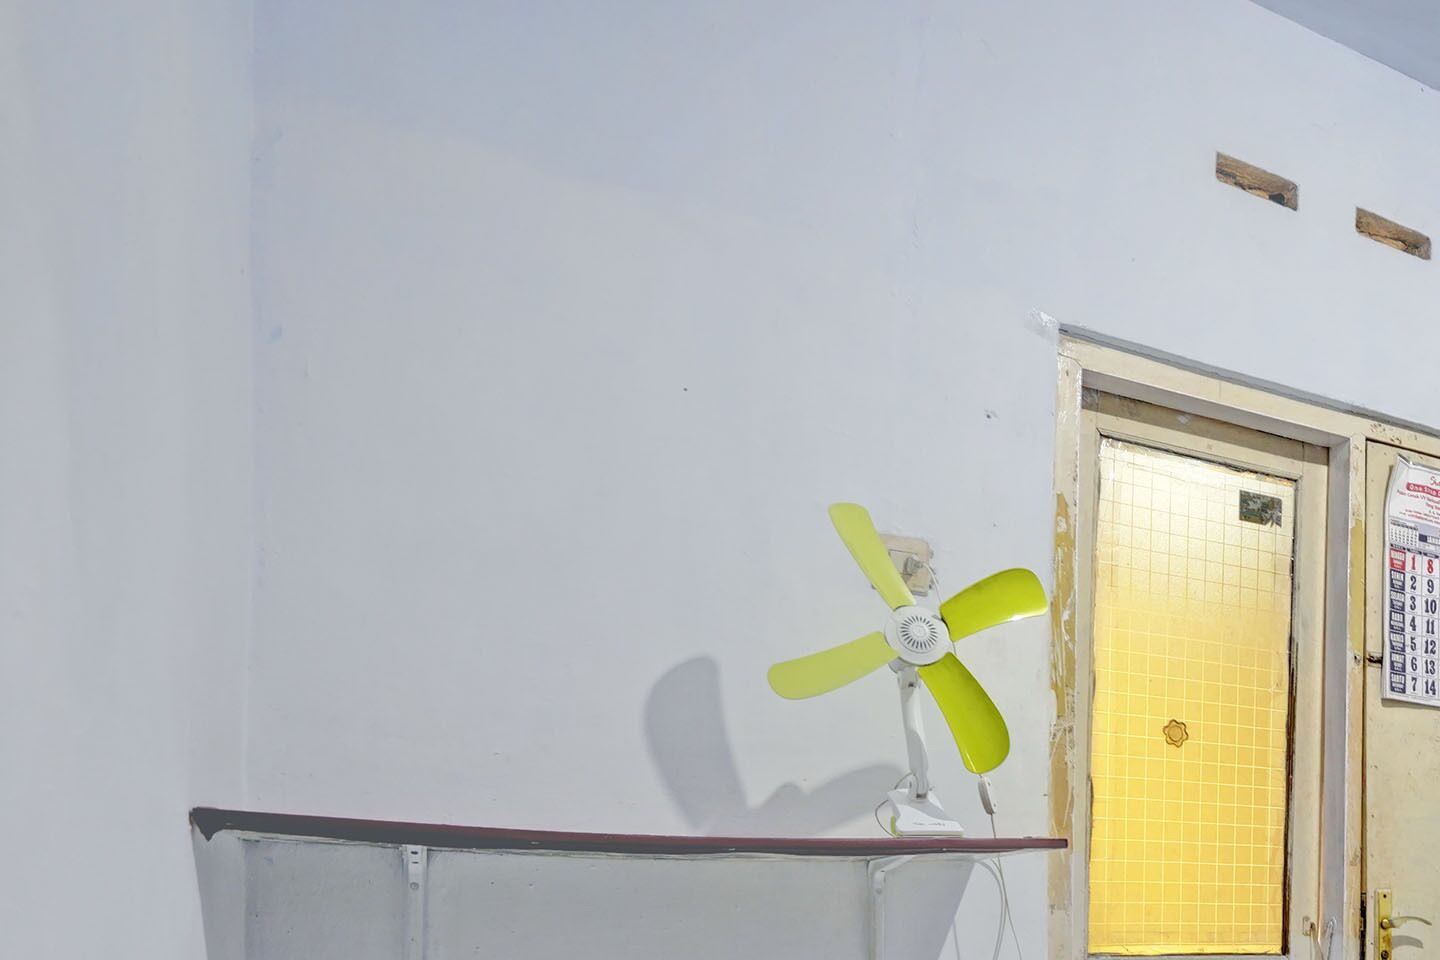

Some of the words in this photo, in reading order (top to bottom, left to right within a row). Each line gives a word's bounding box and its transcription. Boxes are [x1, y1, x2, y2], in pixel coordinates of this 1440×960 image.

[1411, 555, 1416, 570] 1
[1427, 559, 1434, 574] 8
[1410, 575, 1417, 591] 2
[1427, 579, 1434, 594] 9
[1410, 596, 1416, 611] 3
[1425, 598, 1437, 614] 10
[1410, 616, 1416, 631] 4
[1426, 619, 1435, 635] 11
[1410, 636, 1417, 651] 5
[1424, 639, 1436, 655] 12
[1411, 656, 1418, 672] 6
[1425, 659, 1436, 675] 13
[1411, 677, 1417, 692] 7
[1425, 679, 1436, 695] 14
